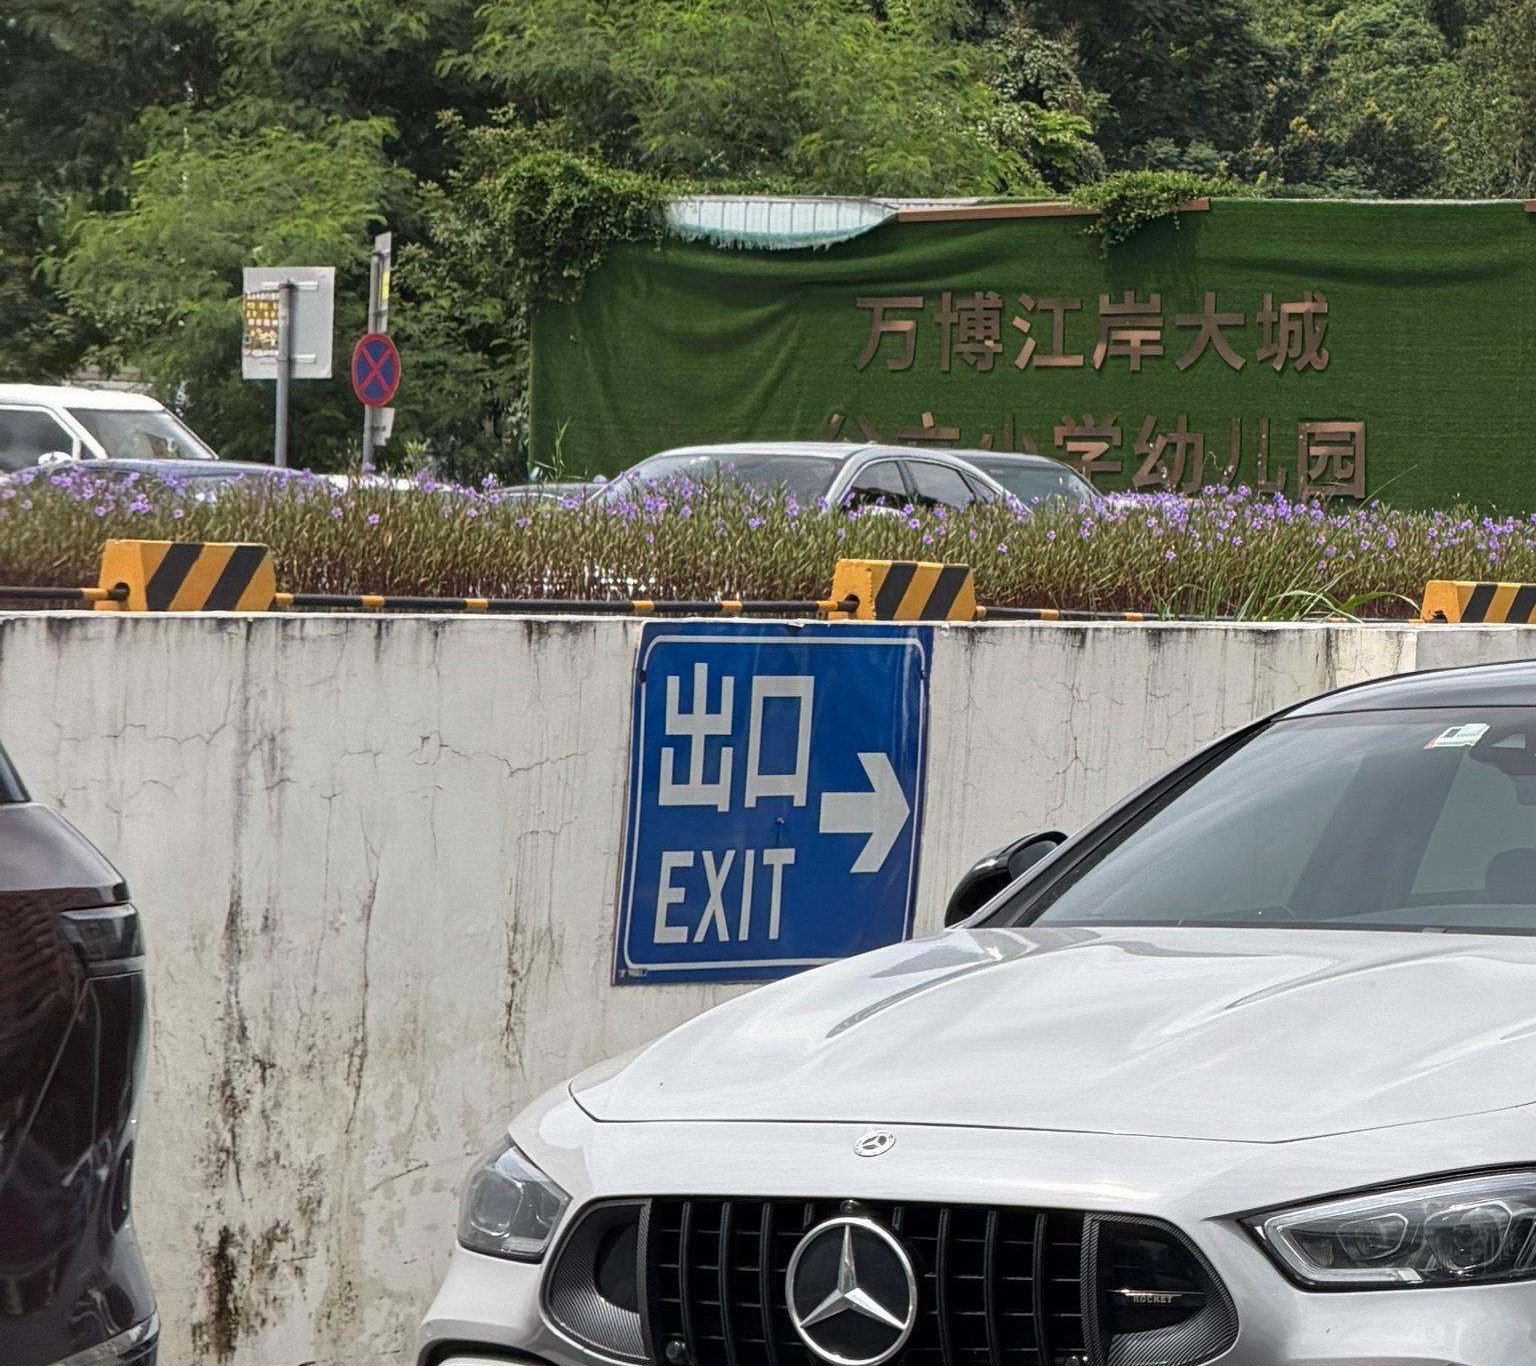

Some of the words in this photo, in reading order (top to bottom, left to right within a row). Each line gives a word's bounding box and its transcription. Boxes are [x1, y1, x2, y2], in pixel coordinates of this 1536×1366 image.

[854, 290, 1329, 373] 万博江岸大城
[826, 411, 1367, 500] 学幼儿园
[658, 662, 815, 812] 出口
[653, 848, 796, 944] EXIT
